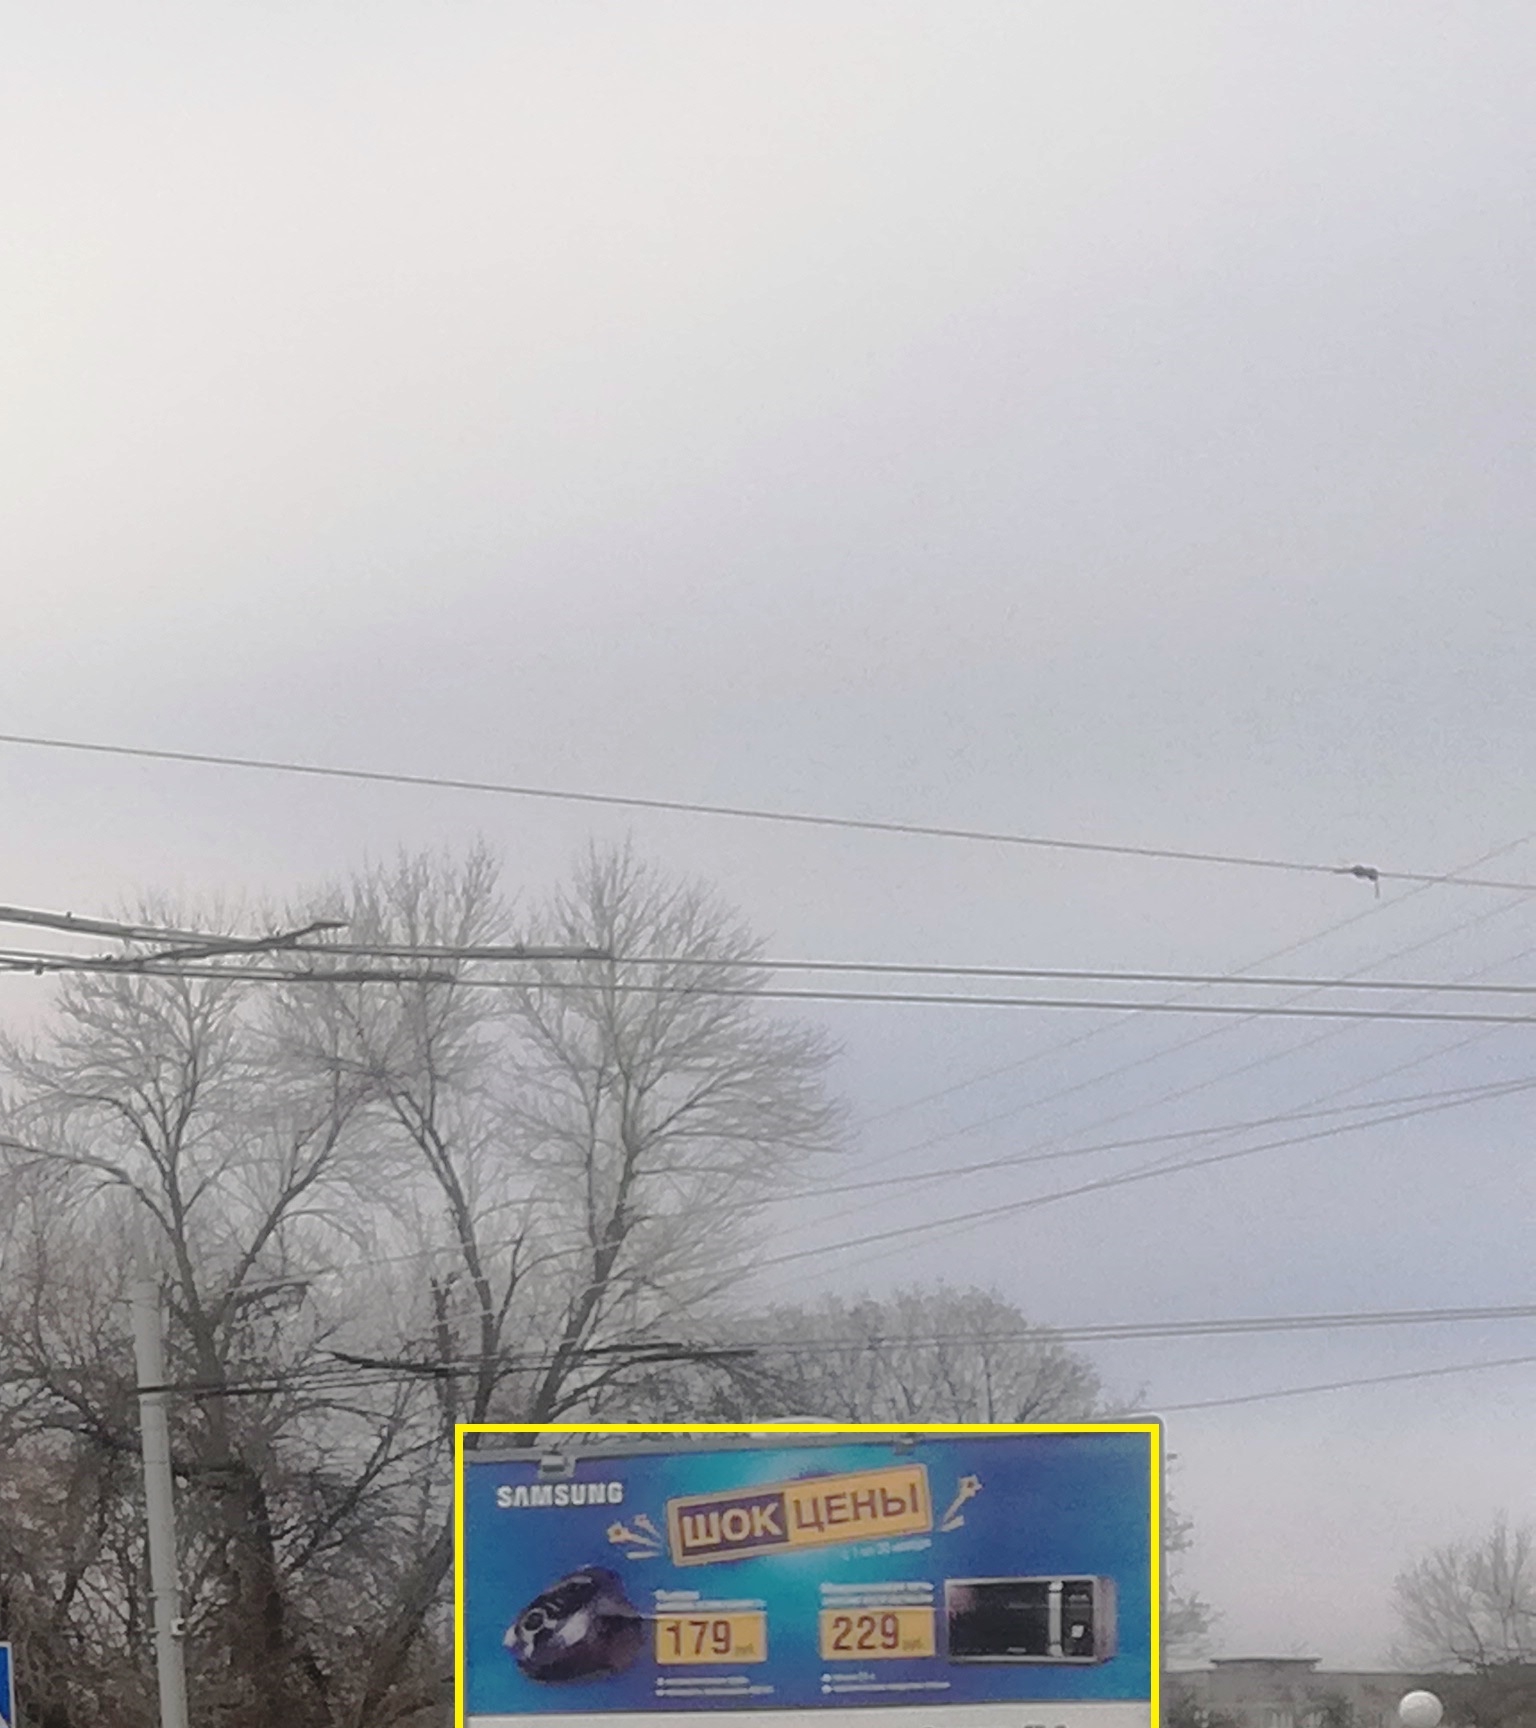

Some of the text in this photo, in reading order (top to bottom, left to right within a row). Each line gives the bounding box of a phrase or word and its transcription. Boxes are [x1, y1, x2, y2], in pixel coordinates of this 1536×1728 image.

[496, 1481, 624, 1508] SAMSUNG
[682, 1483, 920, 1548] ШОК ЦЕНЫ
[666, 1619, 732, 1656] 179
[831, 1612, 900, 1651] 229
